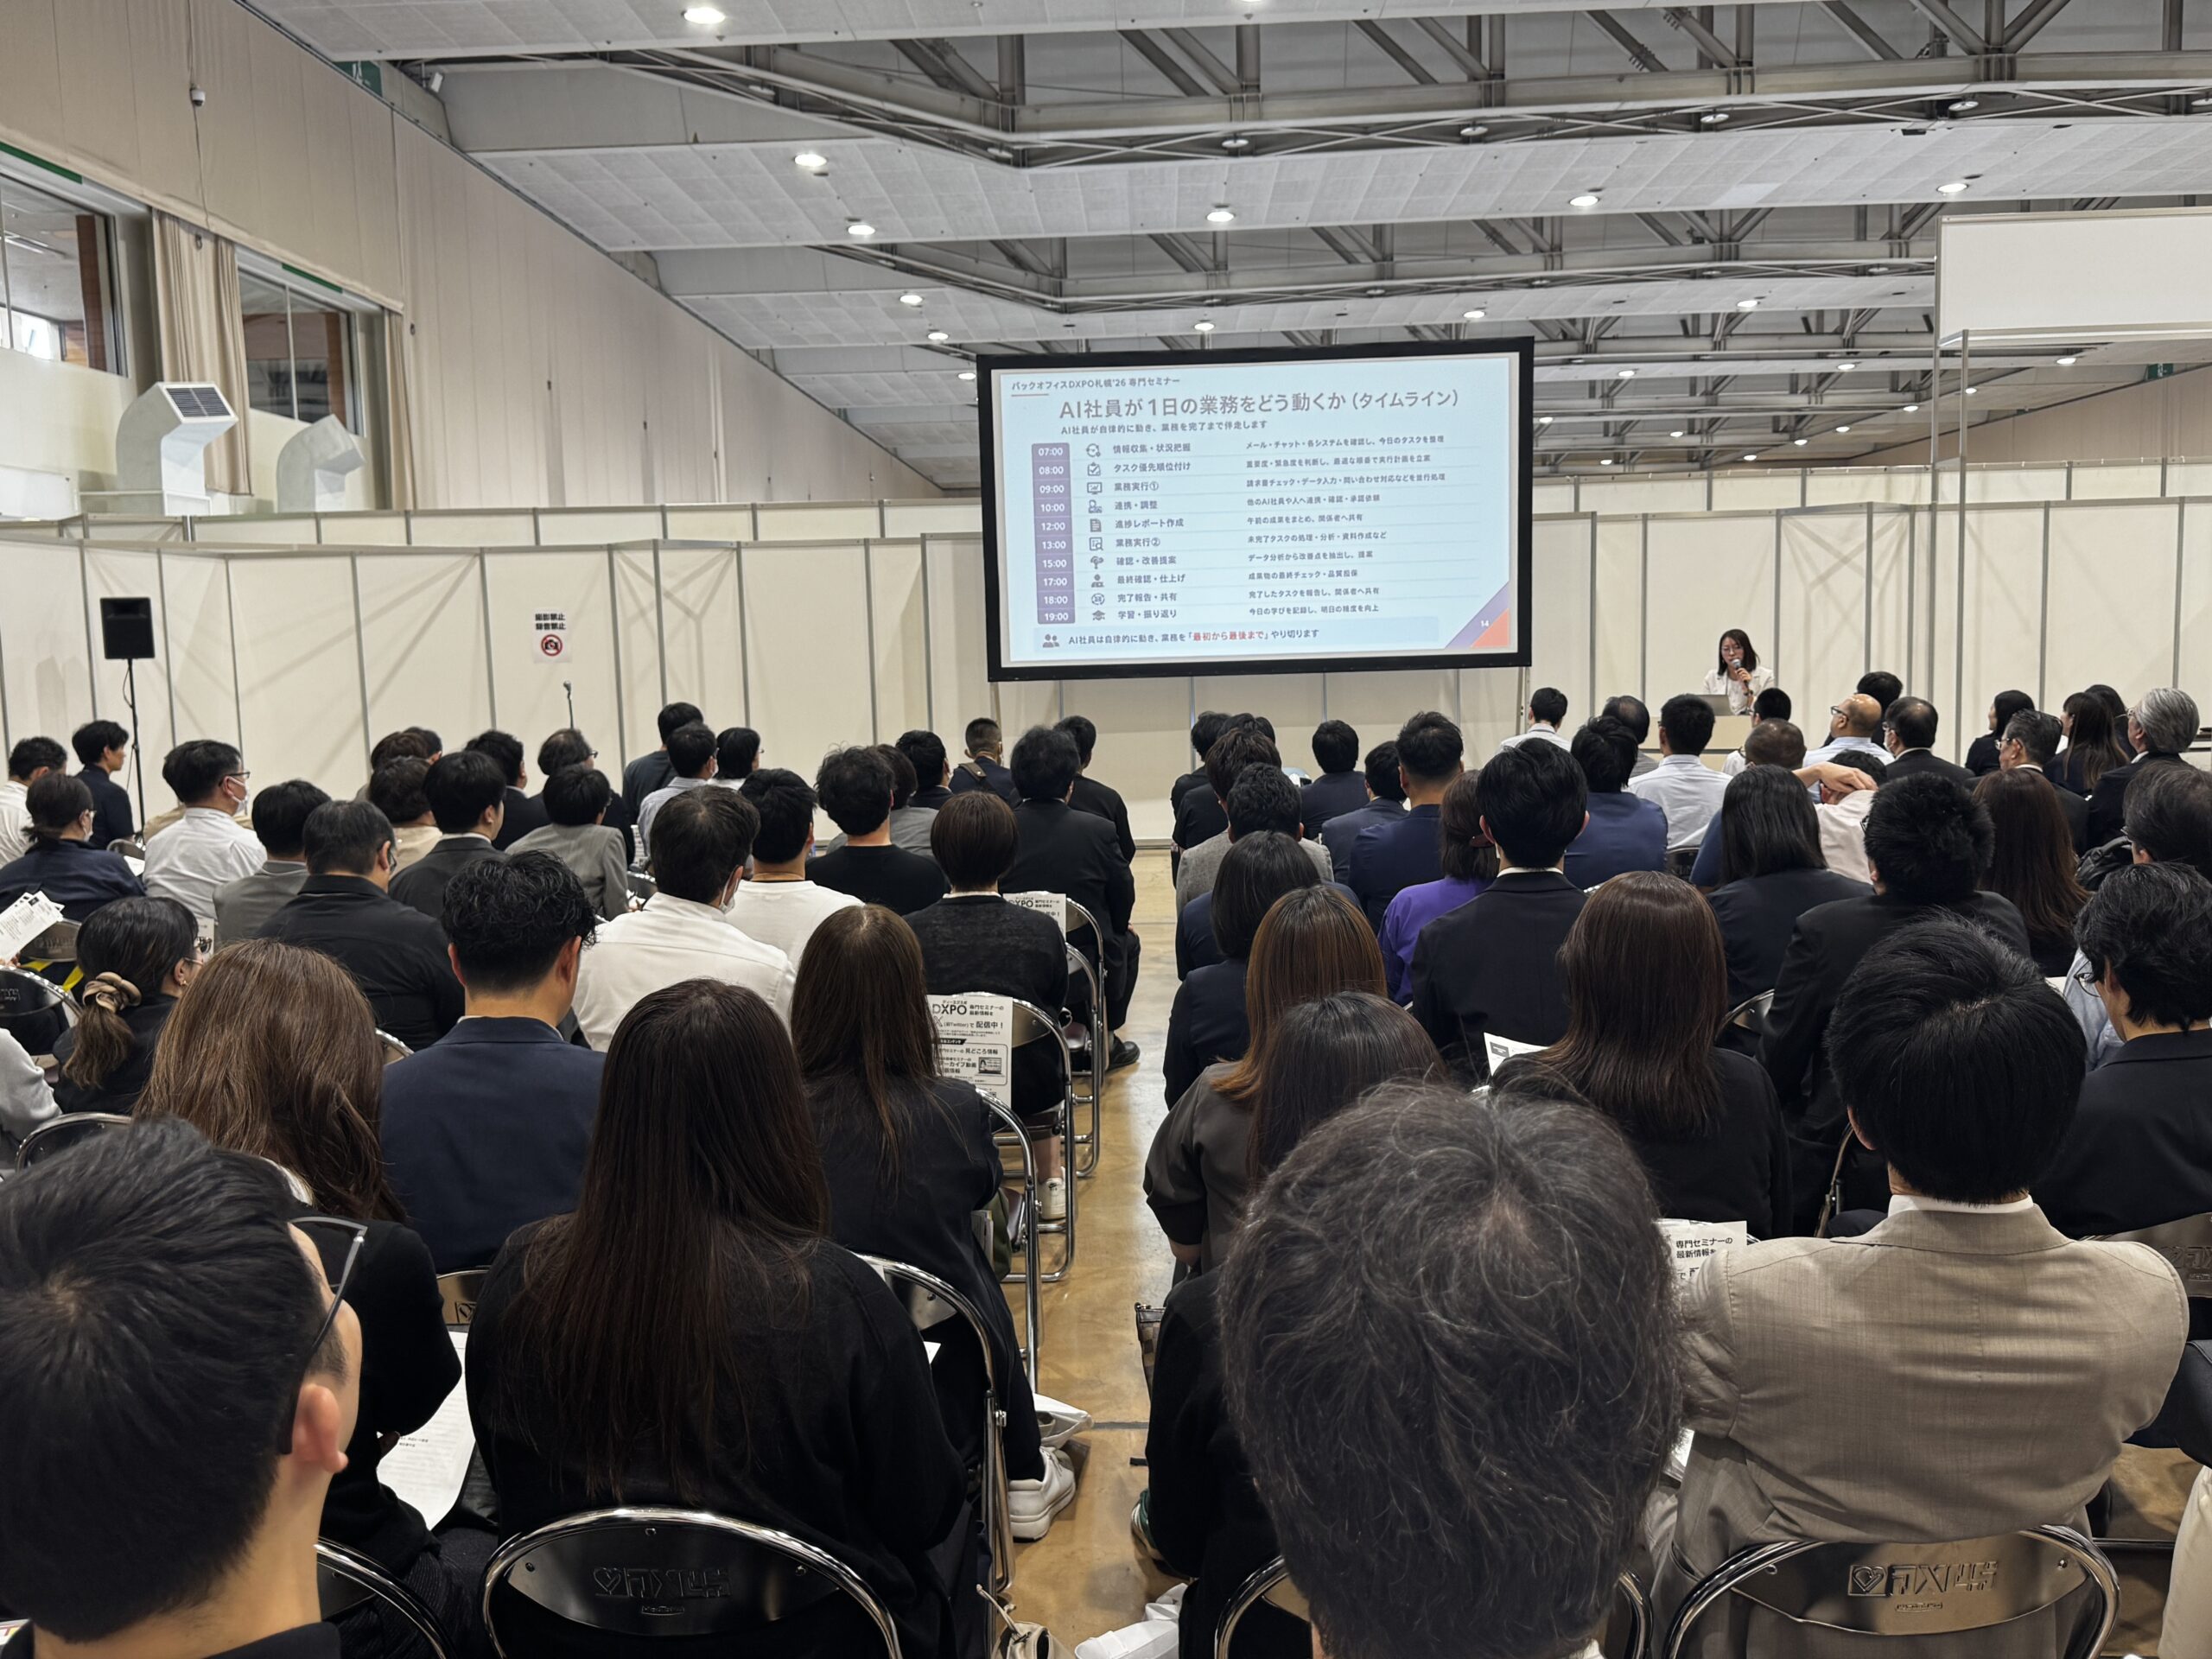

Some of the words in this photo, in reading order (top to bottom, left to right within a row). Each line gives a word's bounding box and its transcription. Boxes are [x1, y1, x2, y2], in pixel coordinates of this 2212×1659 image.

[1128, 378, 1180, 386] 専門セミナー
[1061, 420, 1268, 435] AI社員が自律的に動き、業務を完了まで伴走します
[1039, 448, 1064, 456] 07:00
[1113, 442, 1191, 454] 情報収集・状況把握
[1039, 466, 1064, 475] 08:00
[1114, 461, 1191, 474] タスク優先順位付け
[1039, 485, 1065, 494] 09:00
[1115, 481, 1160, 492] 業務実行①
[1040, 503, 1065, 512] 10:00
[1115, 500, 1158, 511] 連携・調整
[1041, 522, 1065, 531] 12:00
[1115, 518, 1185, 529] 進捗レポート作成
[1042, 540, 1066, 550] 13:00
[1116, 537, 1160, 548] 業務実行②
[1042, 559, 1067, 569] 15:00
[1116, 556, 1177, 566] 確認・改善提案
[1043, 577, 1068, 587] 17:00
[1117, 574, 1185, 584] 最終確認・仕上げ
[1044, 595, 1068, 605] 18:00
[1117, 593, 1178, 603] 完了報告・共有
[1044, 612, 1069, 621] 19:00
[1118, 610, 1178, 620] 学習・振り返り
[932, 1004, 967, 1015] DXPO
[1676, 1237, 1733, 1249] 専門セミナーの
